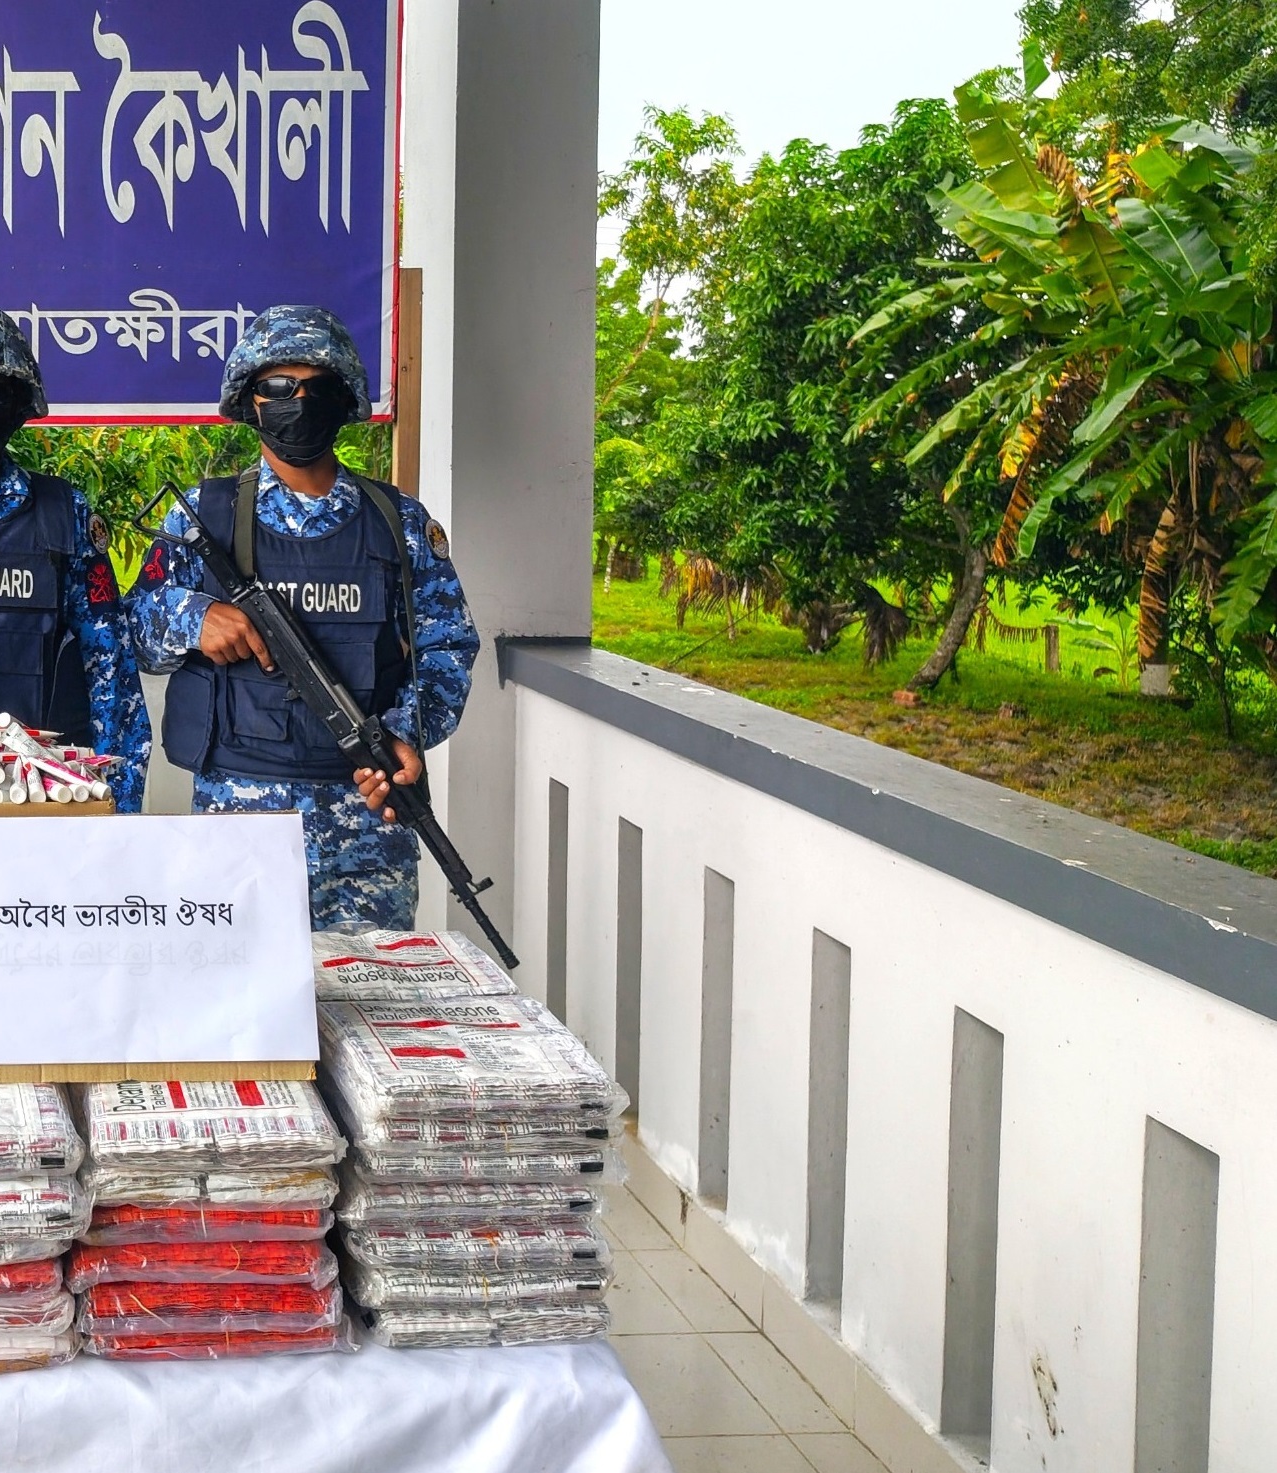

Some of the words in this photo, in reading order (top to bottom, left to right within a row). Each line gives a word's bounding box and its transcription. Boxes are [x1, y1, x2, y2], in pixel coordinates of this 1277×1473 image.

[93, 0, 369, 236] কৈখালী
[302, 583, 361, 612] GUARD
[75, 896, 167, 927] ভারতীয়
[176, 897, 234, 927] ঔষধ
[338, 970, 471, 984] Dexamethasone
